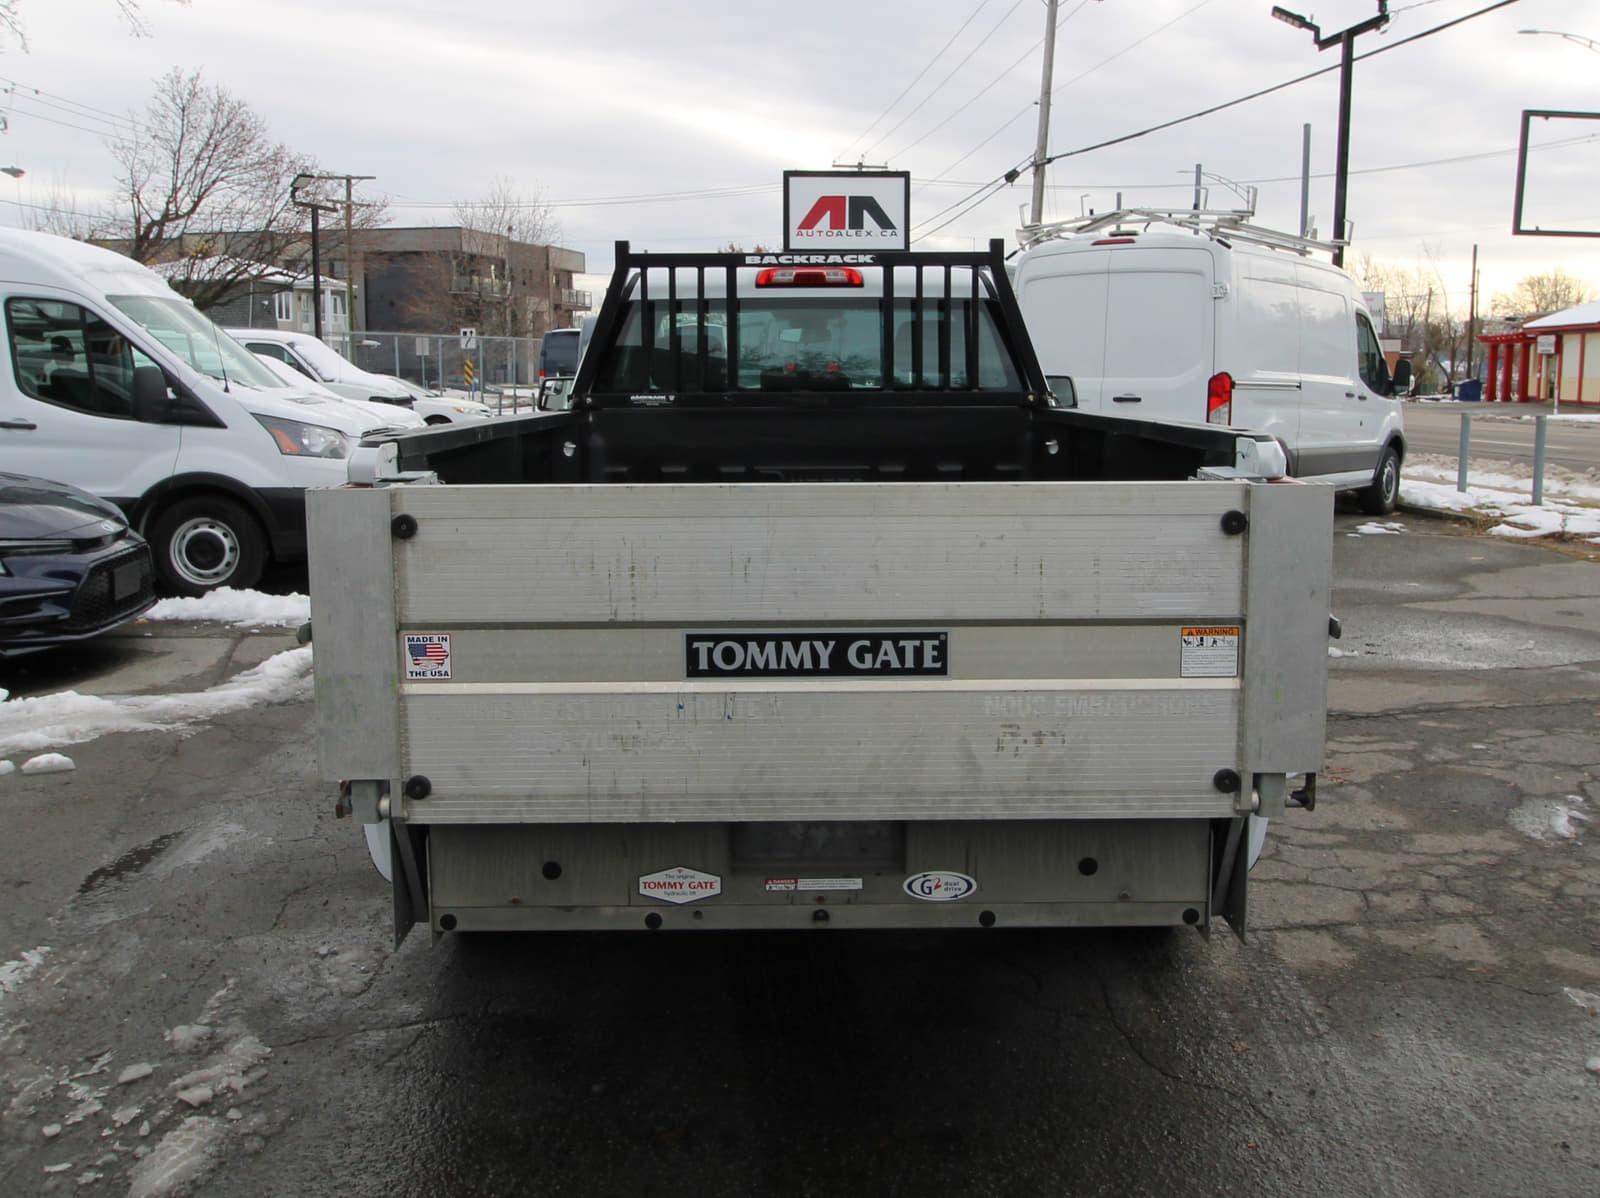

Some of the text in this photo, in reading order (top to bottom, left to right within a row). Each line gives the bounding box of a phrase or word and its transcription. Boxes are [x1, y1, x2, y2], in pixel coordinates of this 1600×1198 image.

[745, 255, 874, 264] BACKRACK
[692, 639, 943, 671] TOMMY GATE
[643, 881, 715, 890] TOMMY GATE
